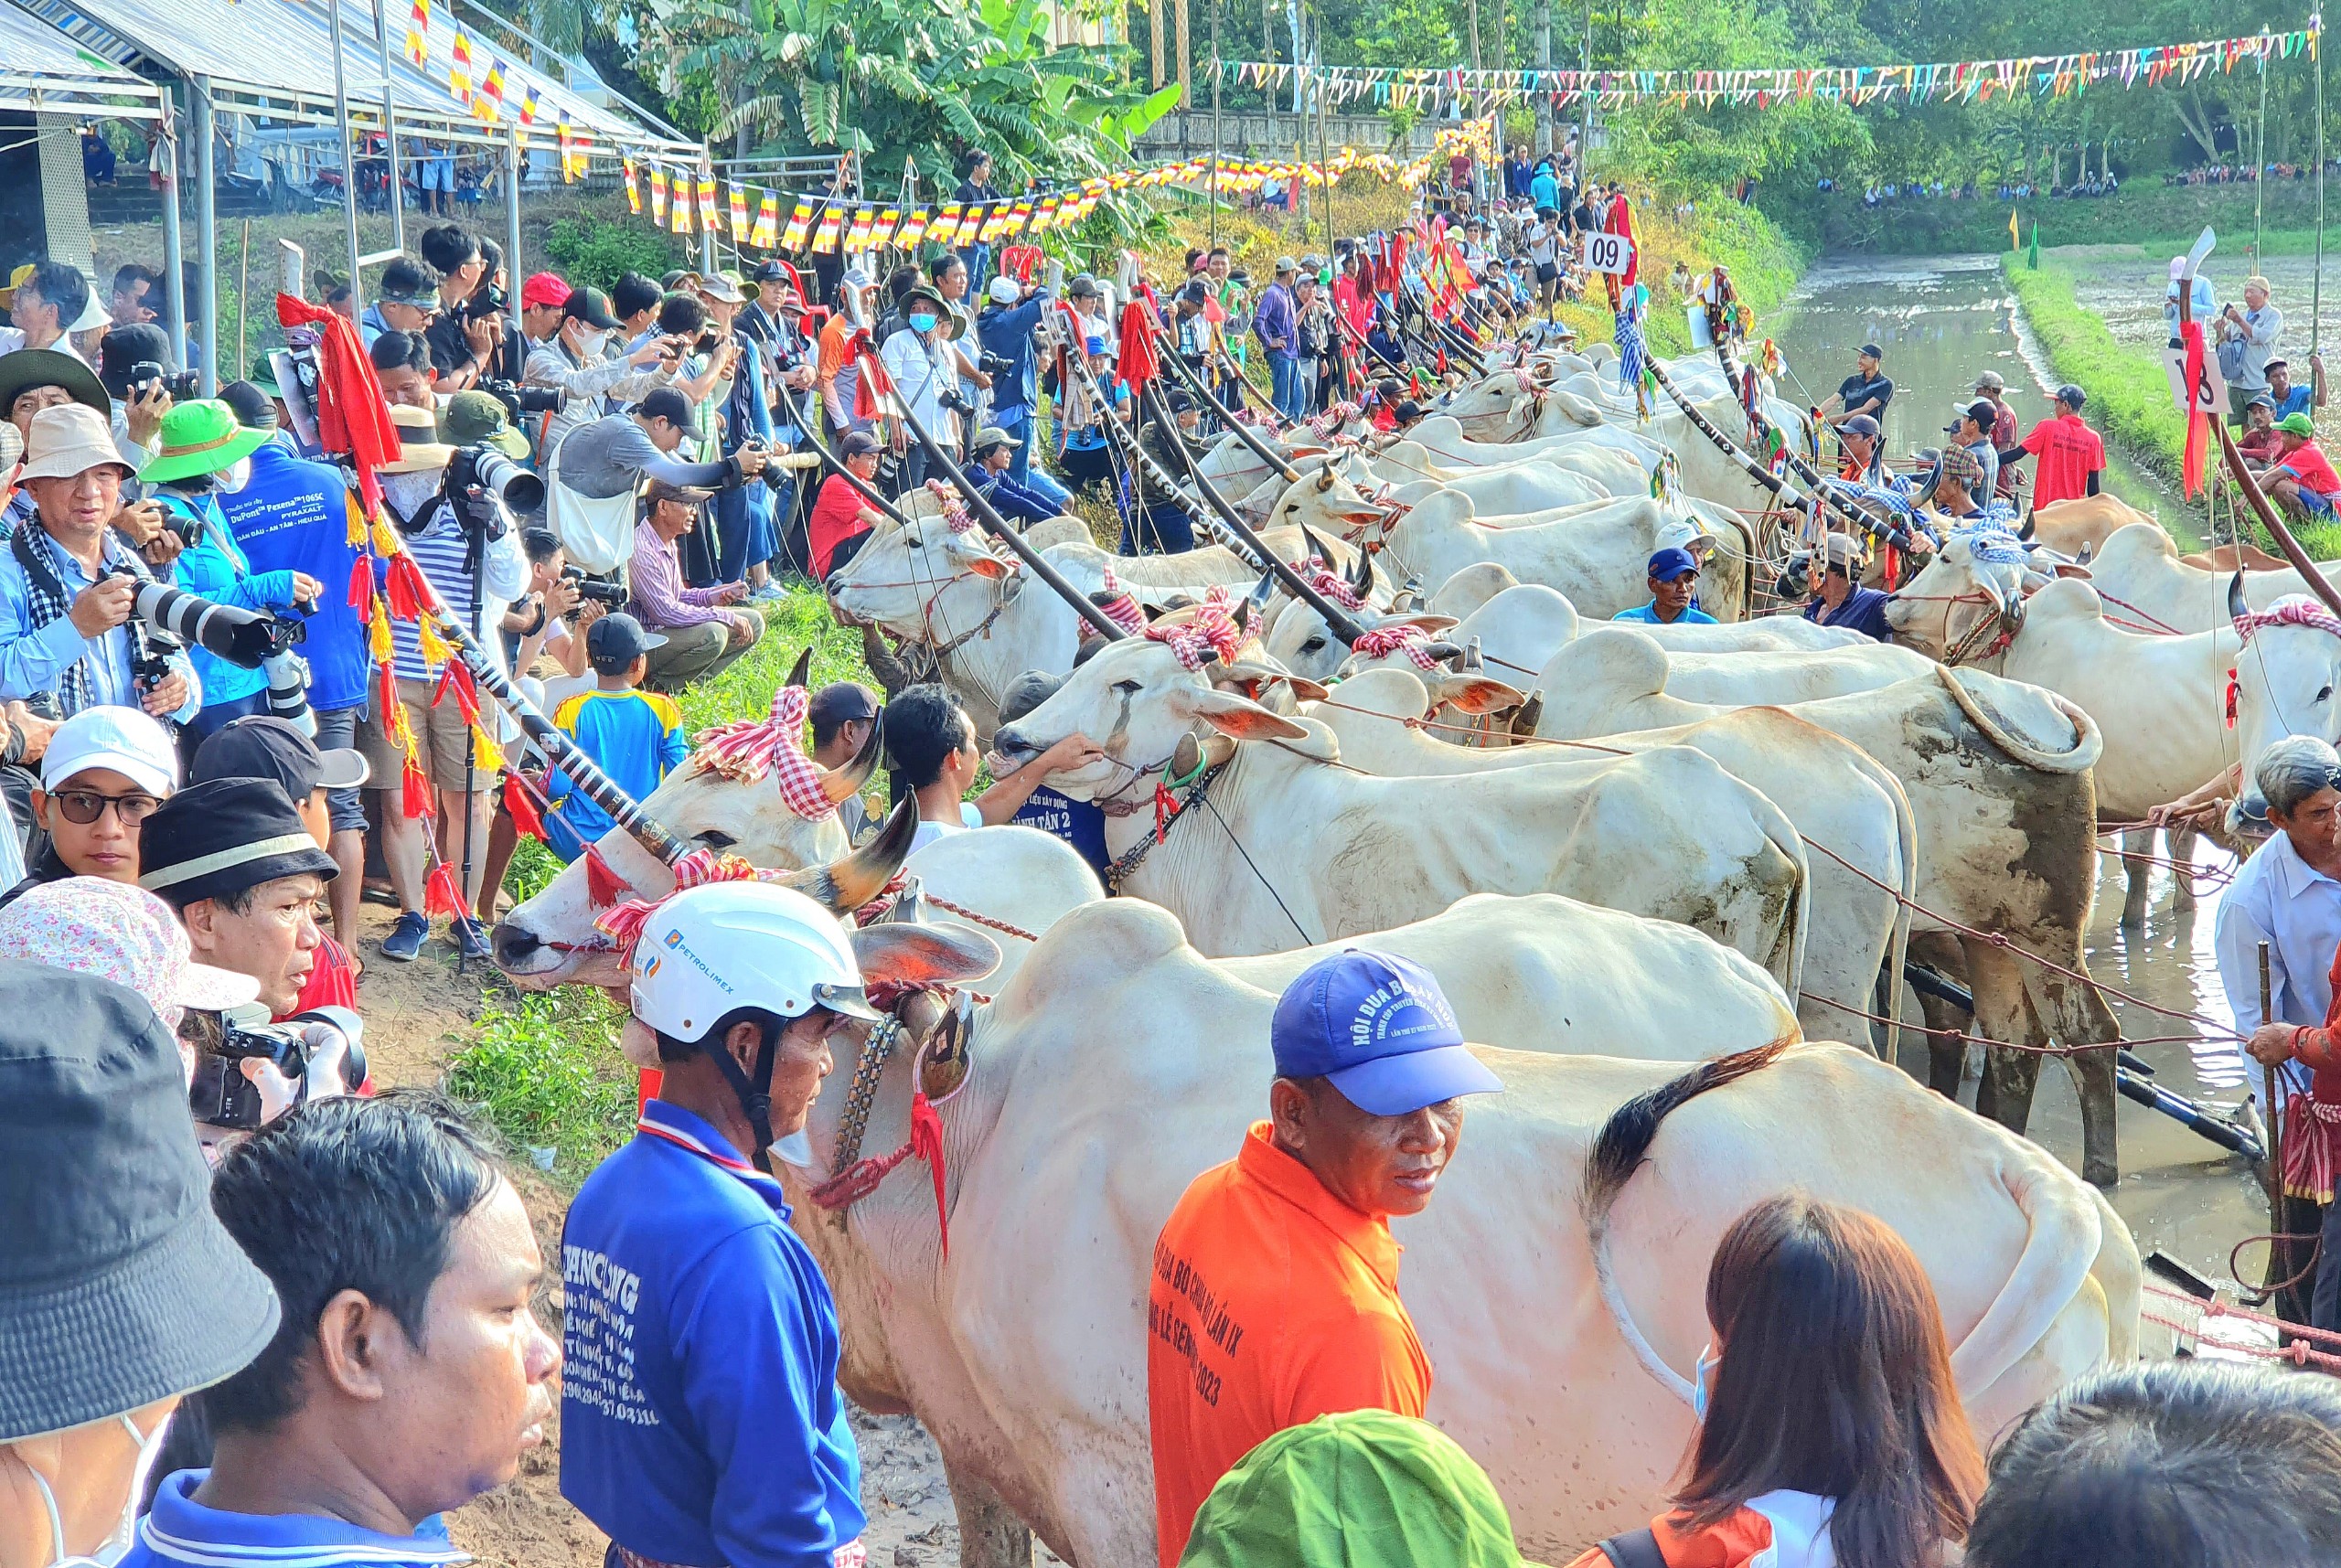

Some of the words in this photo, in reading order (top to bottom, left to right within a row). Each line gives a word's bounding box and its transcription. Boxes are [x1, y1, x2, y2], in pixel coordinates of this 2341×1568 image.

[1592, 238, 1619, 268] 09
[1062, 812, 1071, 828] 2
[679, 944, 734, 995] PETROLIMEX
[1350, 1018, 1374, 1046] HỘI
[1224, 1323, 1244, 1359] IX
[1195, 1360, 1222, 1409] 2023
